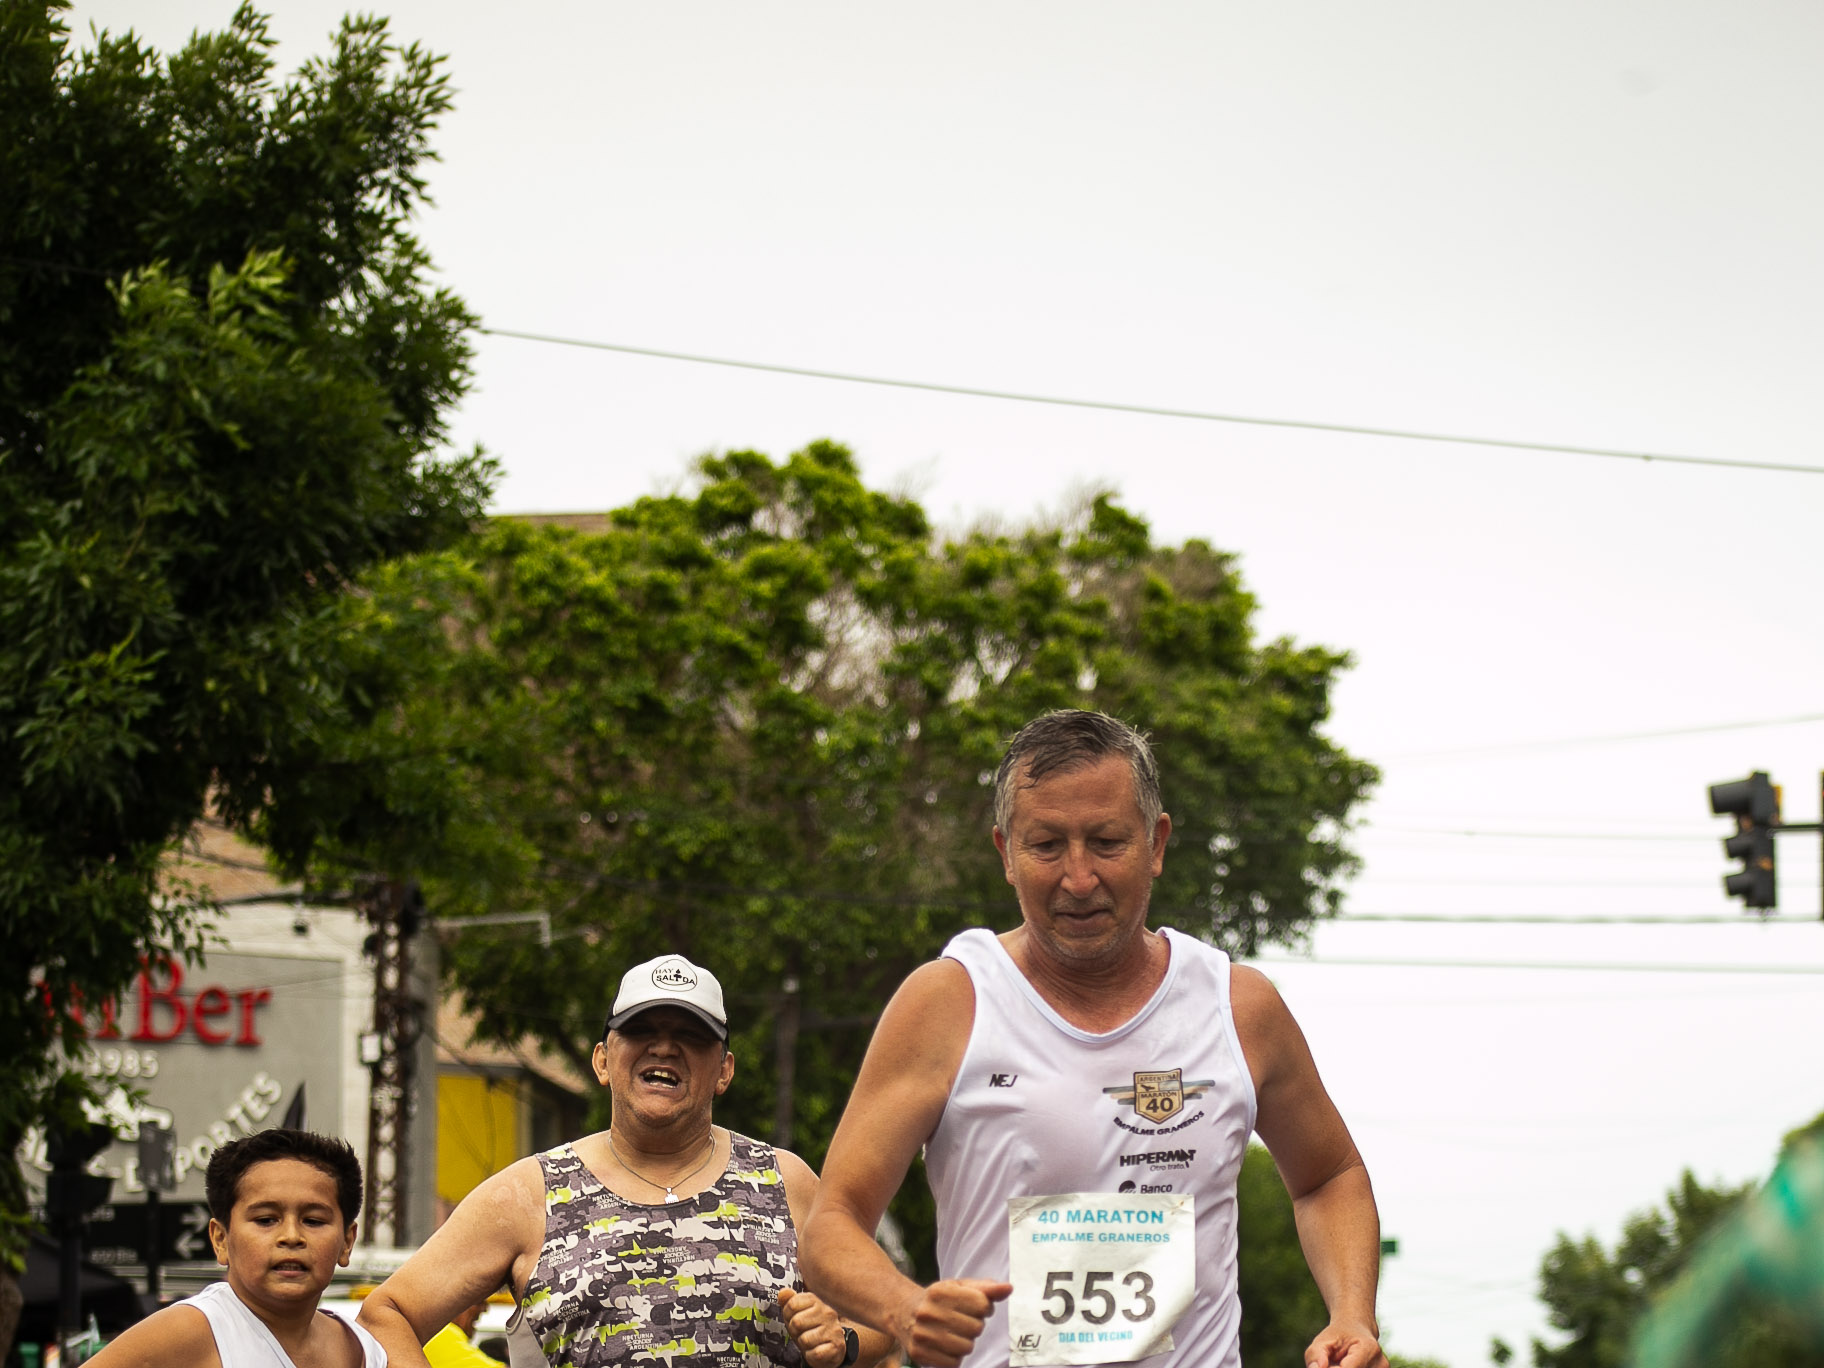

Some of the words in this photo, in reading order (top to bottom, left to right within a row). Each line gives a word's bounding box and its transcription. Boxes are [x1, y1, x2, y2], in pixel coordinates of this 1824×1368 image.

[989, 1073, 1018, 1088] NEJ
[1145, 1098, 1174, 1113] 40
[1113, 1116, 1155, 1136] EMPALME
[1156, 1110, 1205, 1136] GRANEROS
[1140, 1184, 1173, 1194] Banco
[1037, 1210, 1060, 1224] 40
[1066, 1209, 1164, 1224] MARATON
[1032, 1232, 1094, 1243] EMPALME
[1099, 1232, 1170, 1243] GRANEROS
[1040, 1271, 1156, 1325] 553
